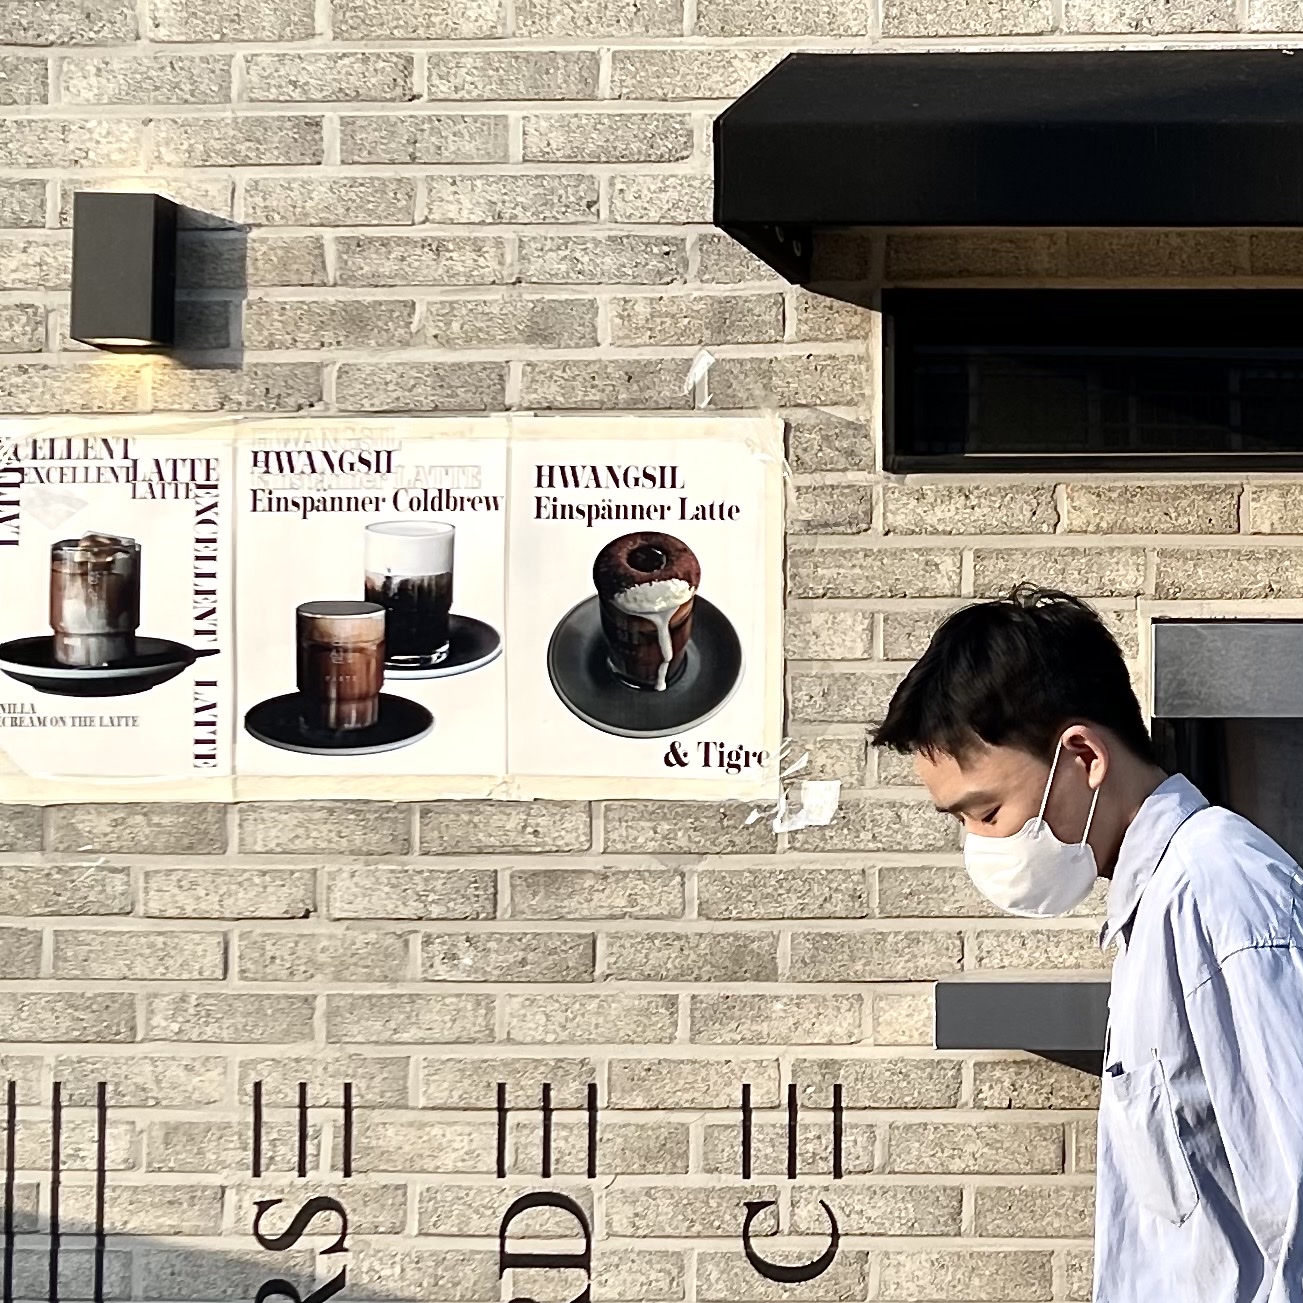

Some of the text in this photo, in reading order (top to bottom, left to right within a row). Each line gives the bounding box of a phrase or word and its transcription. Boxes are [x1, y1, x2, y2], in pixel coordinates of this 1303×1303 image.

[20, 466, 134, 484] EXCELLENT
[130, 457, 220, 483] LATTE
[534, 465, 686, 489] HWANGSIL
[130, 481, 196, 500] LATTE
[249, 488, 504, 520] Einspänner Coldbrew
[533, 496, 741, 528] Einspänner Latte
[193, 482, 220, 643] EXCELLENT
[49, 715, 68, 727] ON
[70, 715, 96, 727] THE
[98, 715, 140, 727] LATTE
[193, 679, 218, 769] LATTE
[663, 740, 771, 775] & Tigre
